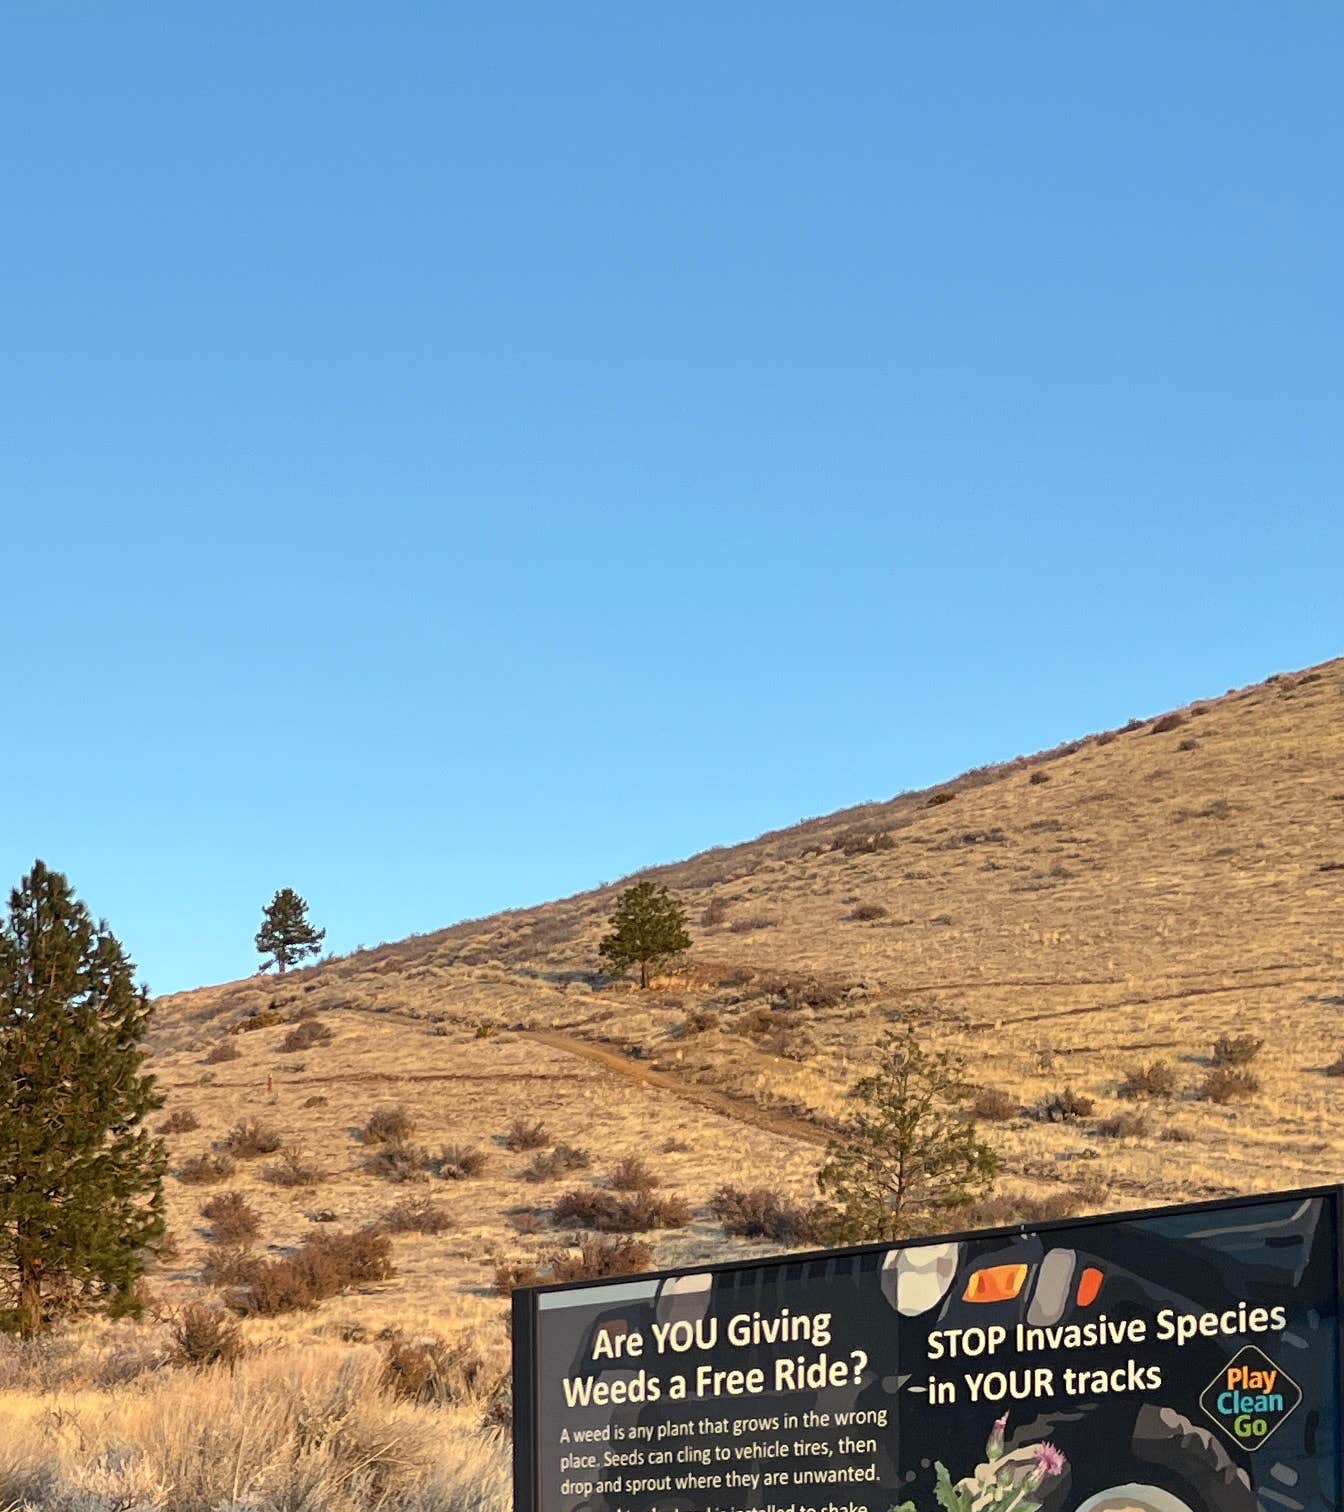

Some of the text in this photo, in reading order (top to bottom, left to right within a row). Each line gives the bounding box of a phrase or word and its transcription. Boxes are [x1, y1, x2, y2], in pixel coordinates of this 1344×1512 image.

[592, 1308, 832, 1360] Are YOU Giving
[927, 1301, 1287, 1360] STOP Invasive Species
[563, 1350, 868, 1408] Weeds a Free Ride?
[928, 1359, 1162, 1405] in YOUR tracks
[1227, 1366, 1277, 1394] Play
[1216, 1392, 1284, 1415] Clean
[560, 1409, 888, 1443] A weed is any plant that grows in the wrong
[1234, 1415, 1268, 1438] Go
[561, 1437, 877, 1472] place. Seeds can cling to vehicle tires, then
[561, 1463, 880, 1497] drop and sprout where they are unwanted.
